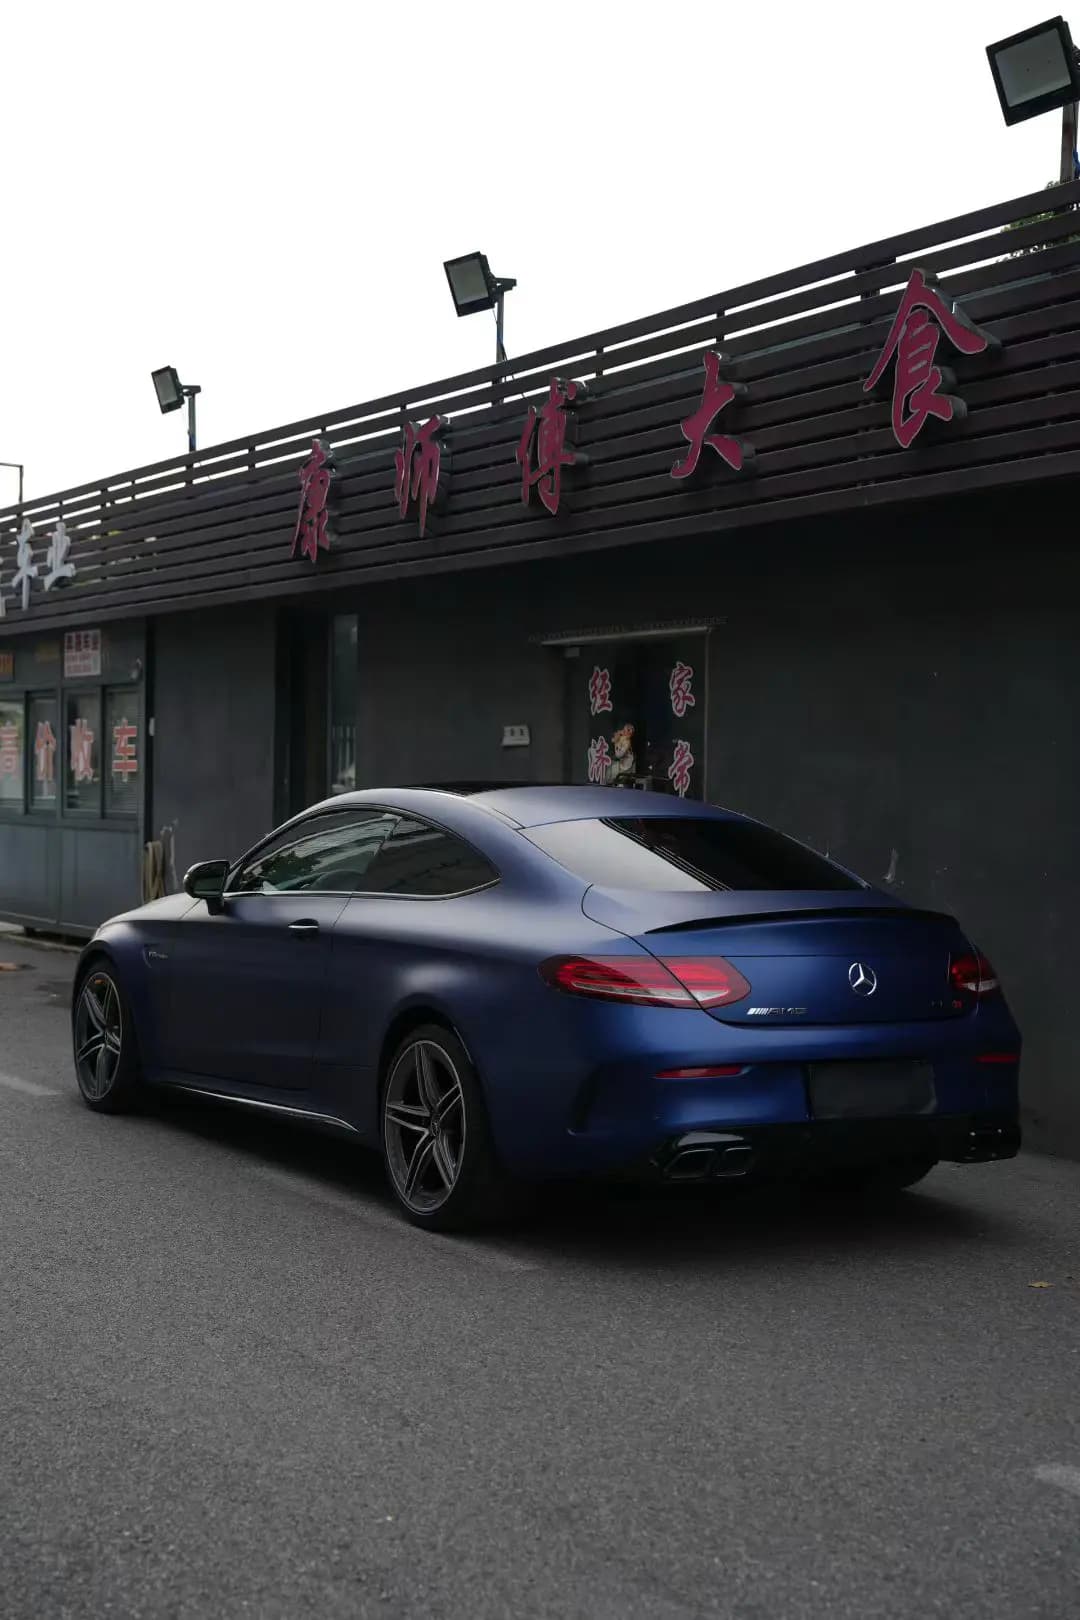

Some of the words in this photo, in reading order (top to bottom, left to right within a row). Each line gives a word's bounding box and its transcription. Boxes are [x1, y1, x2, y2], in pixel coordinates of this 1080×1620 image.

[0, 518, 76, 617] 车业
[0, 717, 138, 783] 高价收车
